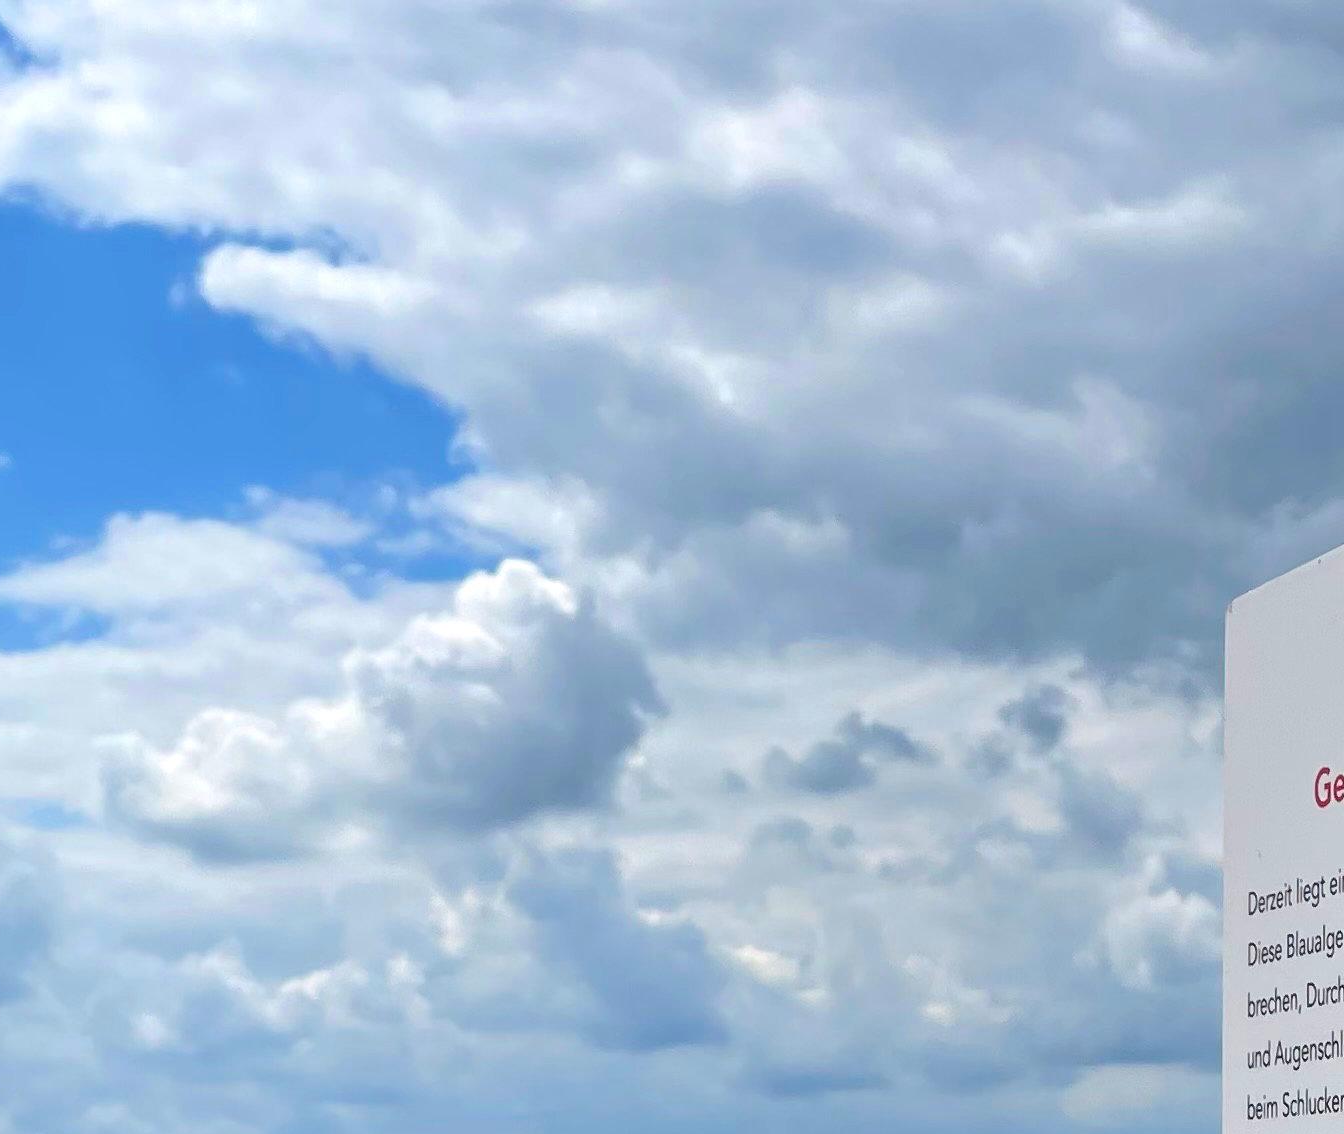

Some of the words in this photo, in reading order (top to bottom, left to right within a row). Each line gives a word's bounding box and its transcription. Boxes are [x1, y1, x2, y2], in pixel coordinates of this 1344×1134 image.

[1248, 883, 1292, 916] Derzeit
[1296, 876, 1326, 907] liegt
[1247, 941, 1282, 966] Diese
[1247, 987, 1301, 1018] brechen,
[1247, 1040, 1271, 1069] und
[1247, 1094, 1278, 1120] beim
